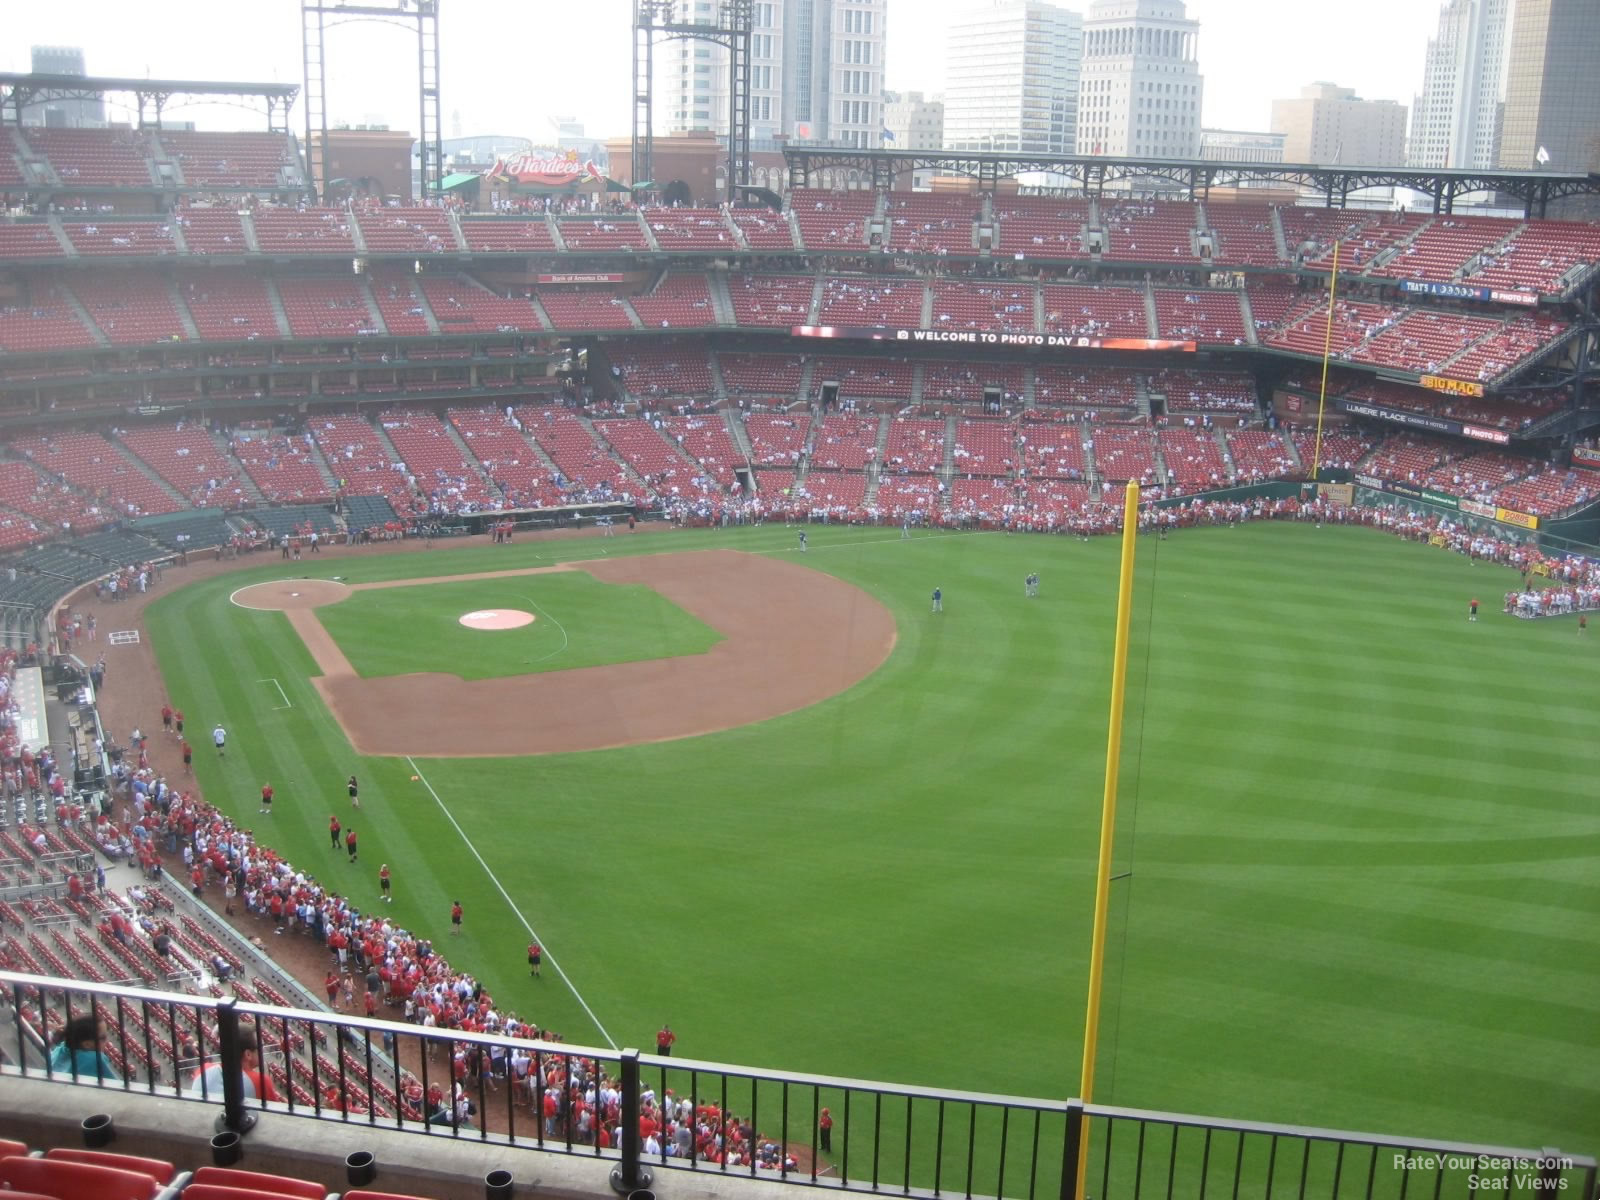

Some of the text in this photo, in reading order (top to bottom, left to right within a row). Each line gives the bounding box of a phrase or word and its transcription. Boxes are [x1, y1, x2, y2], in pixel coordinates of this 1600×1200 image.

[1407, 282, 1437, 293] THAT'S A
[914, 331, 1072, 346] WELCOME TO PHOTO DAY
[1427, 380, 1474, 395] BIG MAC
[1379, 411, 1406, 422] PLACE
[1471, 430, 1507, 442] PHOTO DAY
